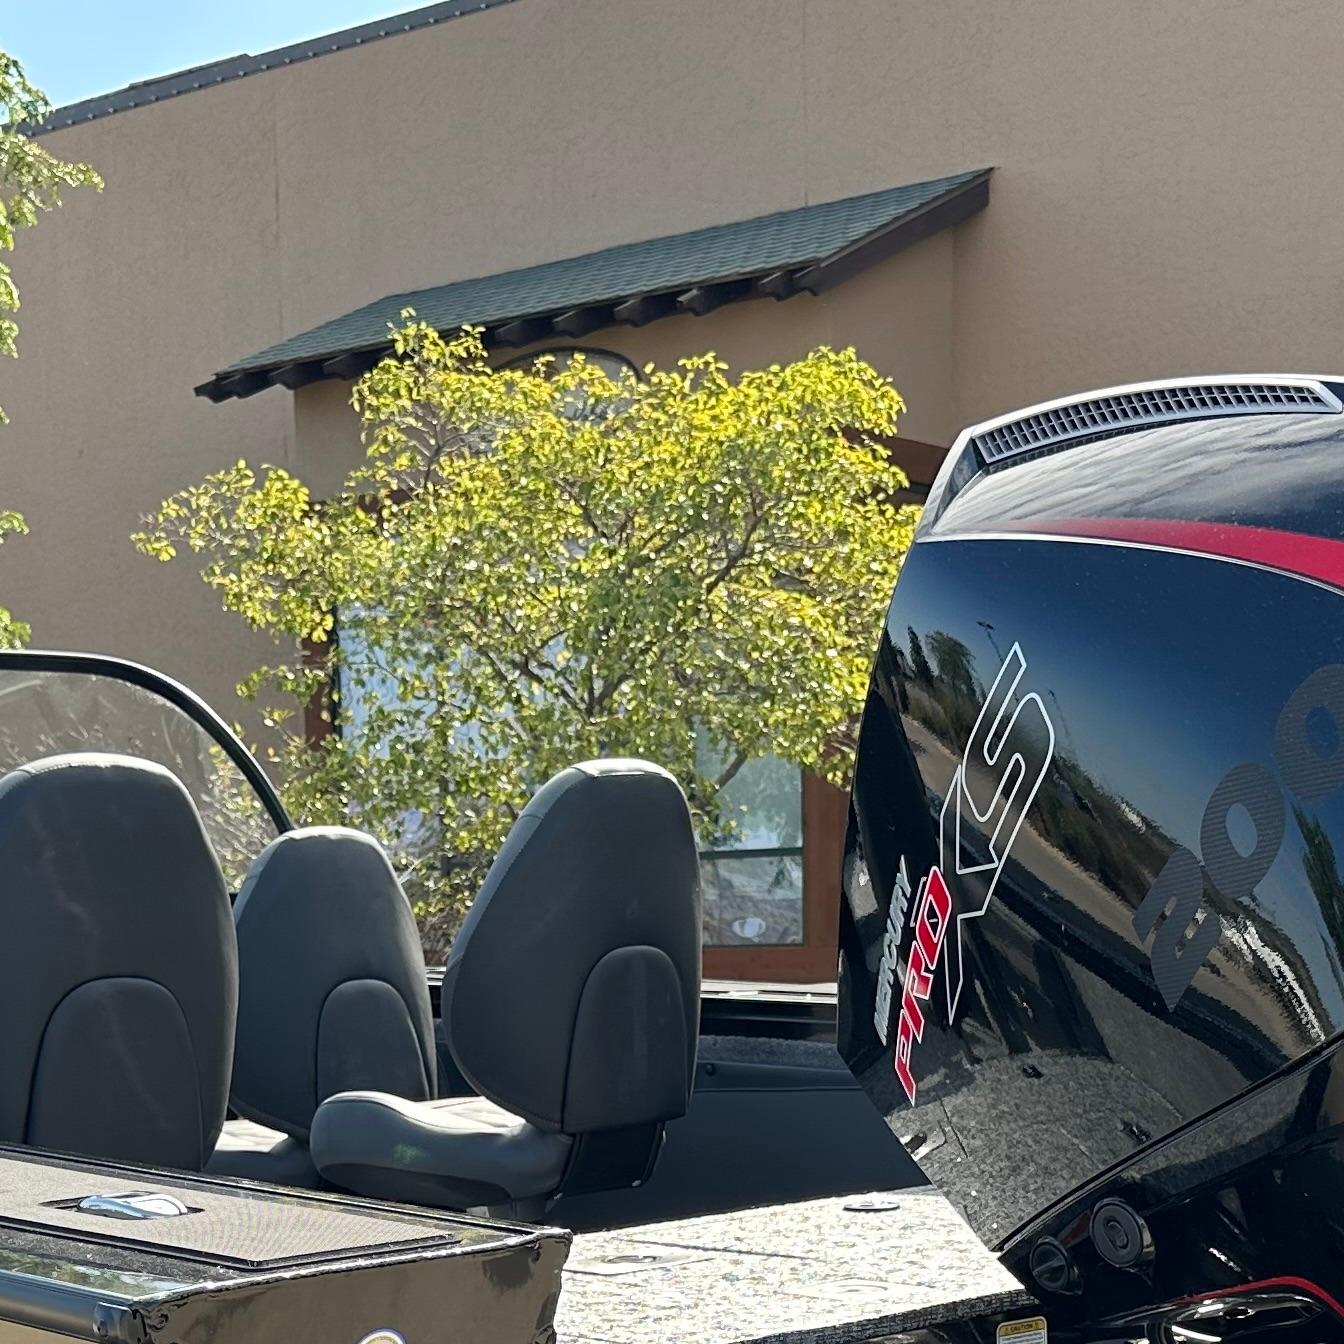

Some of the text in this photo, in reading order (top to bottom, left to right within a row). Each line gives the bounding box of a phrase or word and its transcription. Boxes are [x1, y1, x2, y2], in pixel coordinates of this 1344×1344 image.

[873, 854, 912, 1046] MERCURY
[940, 641, 1055, 1026] XS
[894, 865, 952, 1107] PRO
